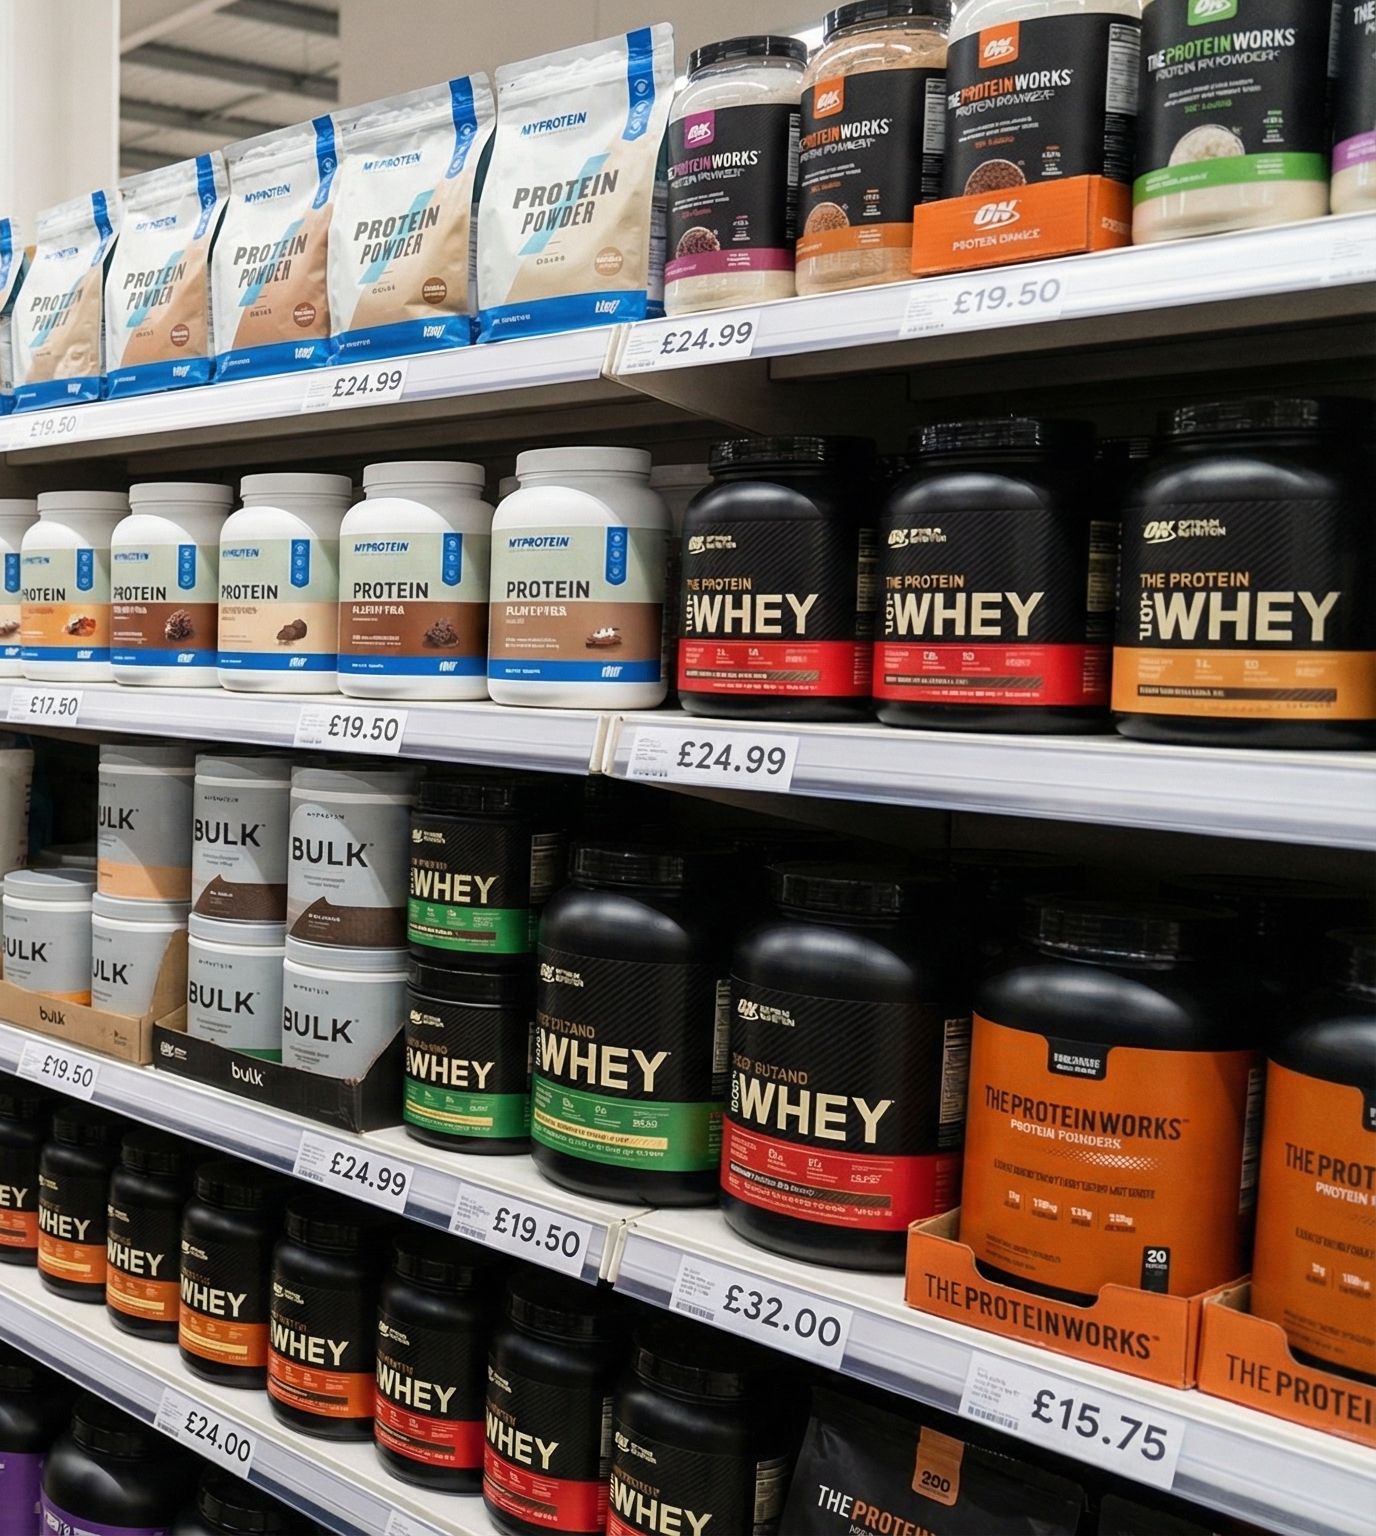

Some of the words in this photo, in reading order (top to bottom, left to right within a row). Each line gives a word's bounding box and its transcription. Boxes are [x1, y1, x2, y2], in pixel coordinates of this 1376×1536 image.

[512, 170, 619, 209] PROTEIN
[354, 205, 440, 241] PROTEIN
[521, 201, 595, 234] POWDER
[233, 234, 308, 265] PROTEIN
[359, 234, 423, 264] POWDER
[123, 262, 187, 289] PROTEIN
[238, 259, 291, 288] POWDER
[952, 278, 1061, 315] £19.50
[660, 322, 753, 354] £24.99
[332, 370, 403, 397] £24.99
[30, 416, 77, 436] £19.50
[221, 584, 278, 599] PROTEIN
[353, 582, 429, 599] PROTEIN
[506, 581, 590, 598] PROTEIN
[702, 577, 751, 590] PROTEIN
[904, 575, 964, 588] PROTEIN
[1140, 574, 1165, 588] THE
[1170, 572, 1249, 588] PROTEIN
[693, 593, 819, 635] WHEY
[893, 592, 1044, 637] WHEY
[1154, 592, 1341, 641] WHEY
[30, 696, 78, 716] £17.50
[328, 715, 399, 741] £19.50
[678, 741, 786, 775] £24.99
[99, 805, 135, 830] ULK
[195, 818, 261, 847] BULK
[292, 837, 368, 868] BULK
[414, 868, 498, 903] WHEY
[189, 981, 255, 1014] BULK
[284, 1006, 353, 1043] BULK
[42, 1055, 93, 1087] £19.50
[232, 1062, 263, 1087] bulk
[410, 1051, 494, 1089] WHEY
[541, 1028, 669, 1092] WHEY
[739, 1073, 892, 1143] WHEY
[330, 1152, 406, 1196] £24.99
[39, 1204, 90, 1241] WHEY
[493, 1207, 580, 1258] £19.50
[107, 1238, 164, 1277] WHEY
[1147, 1250, 1166, 1263] 20
[181, 1273, 247, 1317] WHEY
[723, 1284, 842, 1347] £32.00
[272, 1320, 349, 1366] WHEY
[378, 1365, 456, 1413] WHEY
[185, 1412, 250, 1462] £24.00
[486, 1413, 559, 1470] WHEY
[1032, 1388, 1168, 1462] £15.75
[921, 1470, 951, 1493] 200
[614, 1477, 713, 1536] WHEY
[817, 1485, 853, 1519] THE
